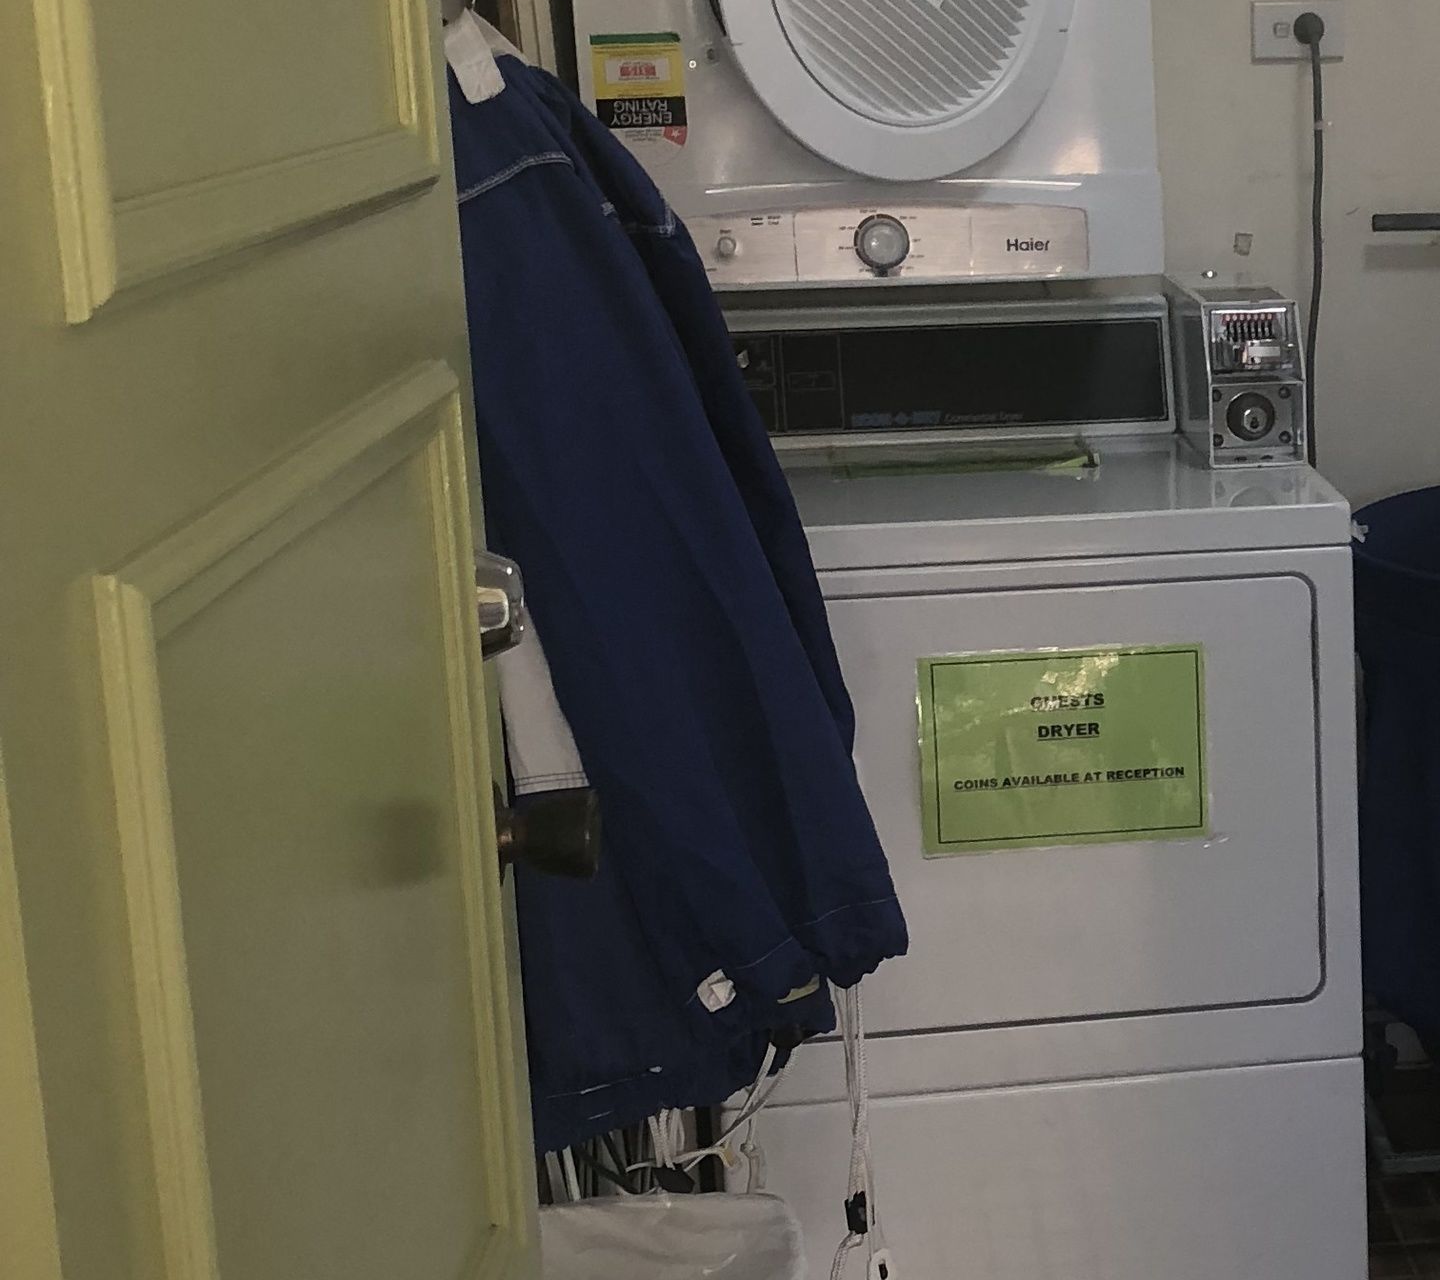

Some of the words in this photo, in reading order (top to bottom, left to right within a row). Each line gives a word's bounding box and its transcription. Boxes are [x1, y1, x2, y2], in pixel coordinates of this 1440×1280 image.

[613, 99, 668, 113] RATING
[610, 112, 673, 126] ENERGY
[1006, 237, 1050, 251] Haier
[1037, 722, 1100, 738] DRYER
[953, 777, 998, 791] COINS
[1002, 772, 1080, 788] AVAILABLE
[1083, 770, 1102, 783] AT
[1106, 766, 1185, 781] RECEPTION
